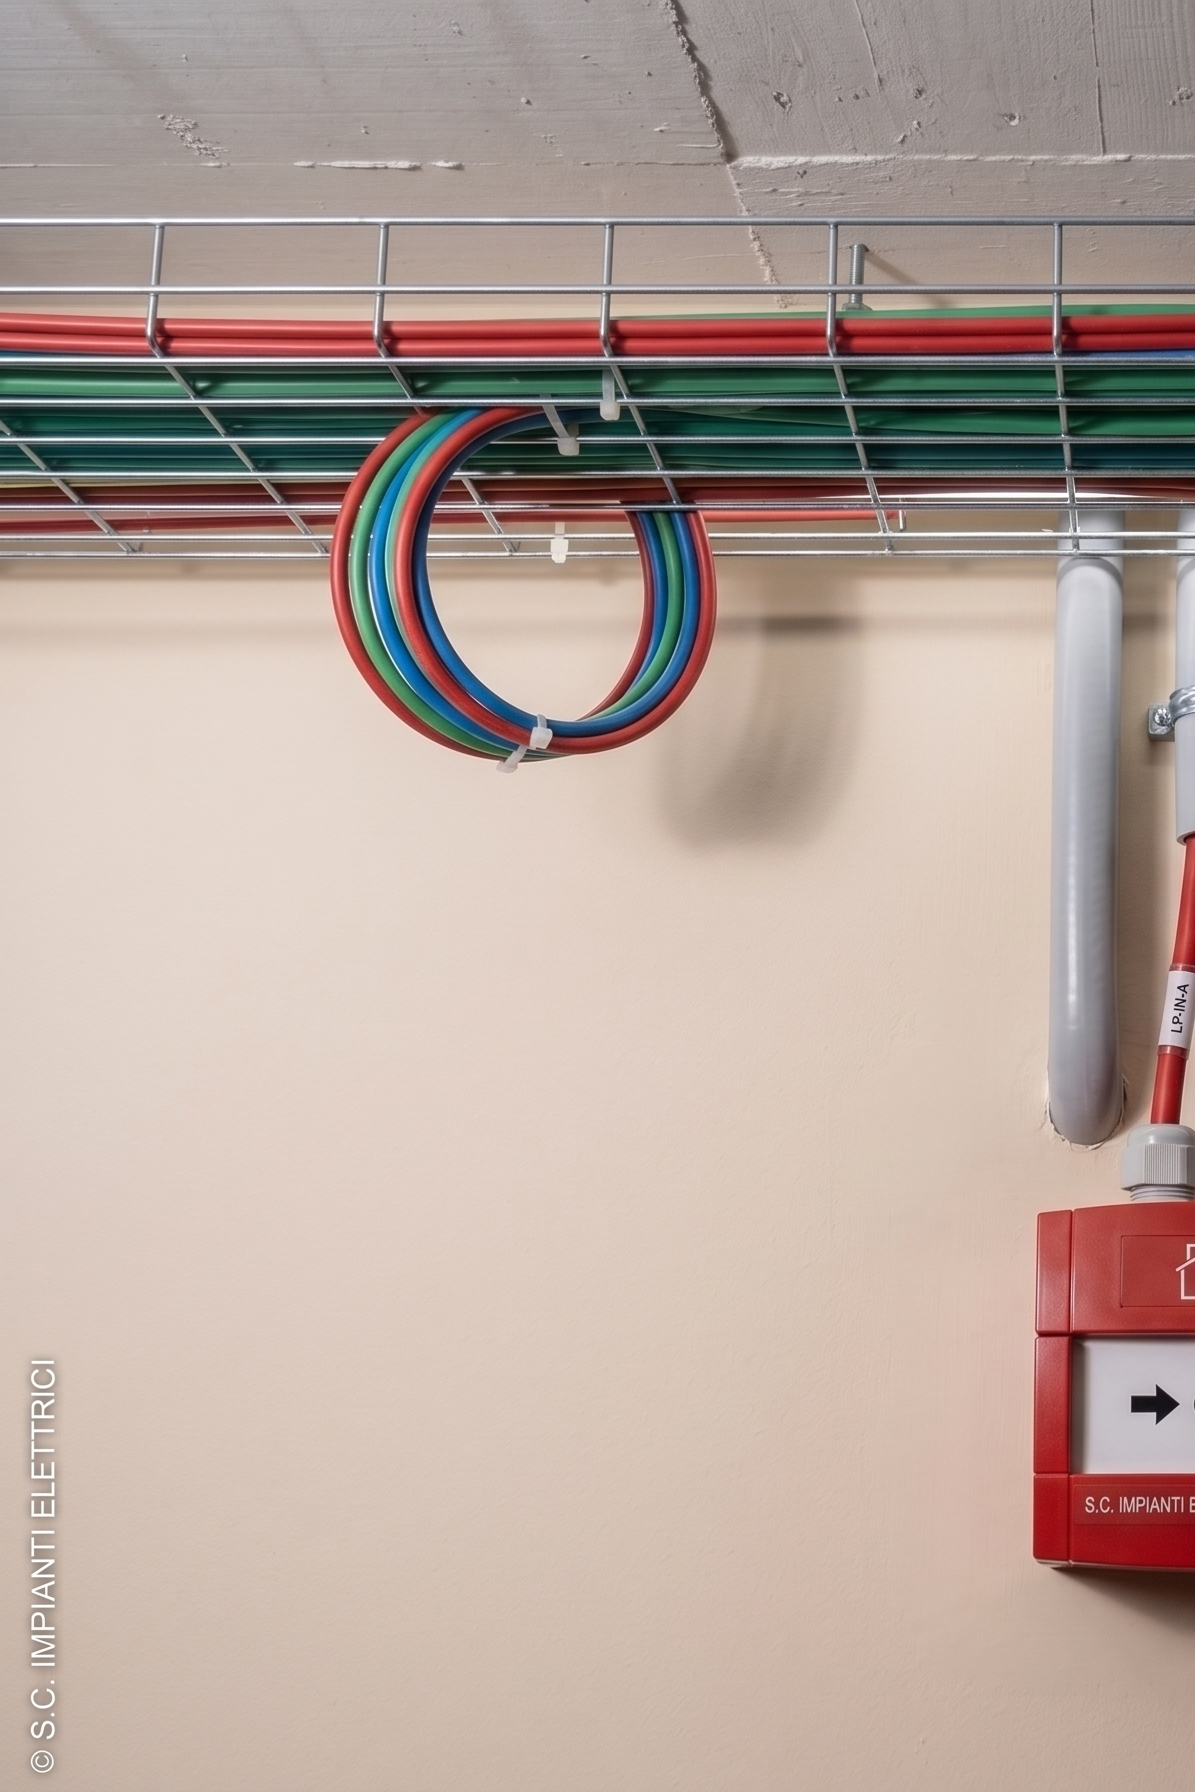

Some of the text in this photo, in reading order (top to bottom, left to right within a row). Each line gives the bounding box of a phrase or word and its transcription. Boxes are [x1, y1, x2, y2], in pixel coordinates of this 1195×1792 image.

[1170, 983, 1190, 1034] LP-IN-A
[1084, 1496, 1114, 1514] S.C.
[1119, 1496, 1185, 1514] IMPIANTI
